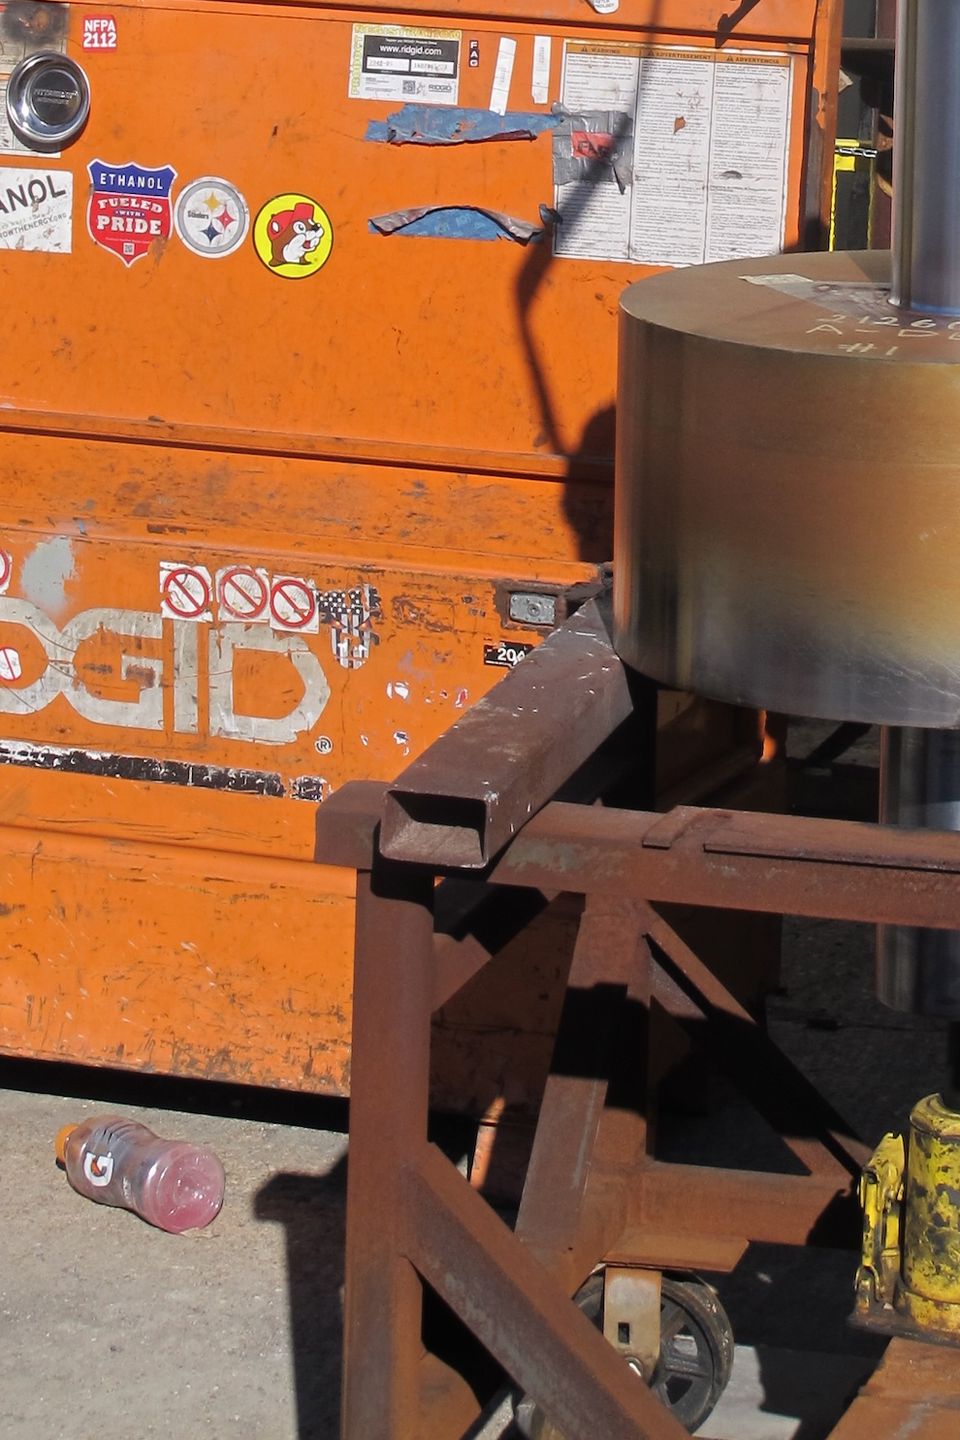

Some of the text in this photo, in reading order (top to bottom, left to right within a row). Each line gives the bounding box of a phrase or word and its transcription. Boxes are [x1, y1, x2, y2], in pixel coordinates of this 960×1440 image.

[85, 19, 116, 32] NFPA
[83, 32, 117, 48] 2112
[379, 44, 442, 56] www.ridgid.com
[100, 173, 163, 190] ETHANOL
[98, 198, 163, 213] FUELED
[97, 215, 161, 235] PRIDE
[84, 1151, 113, 1186] G
